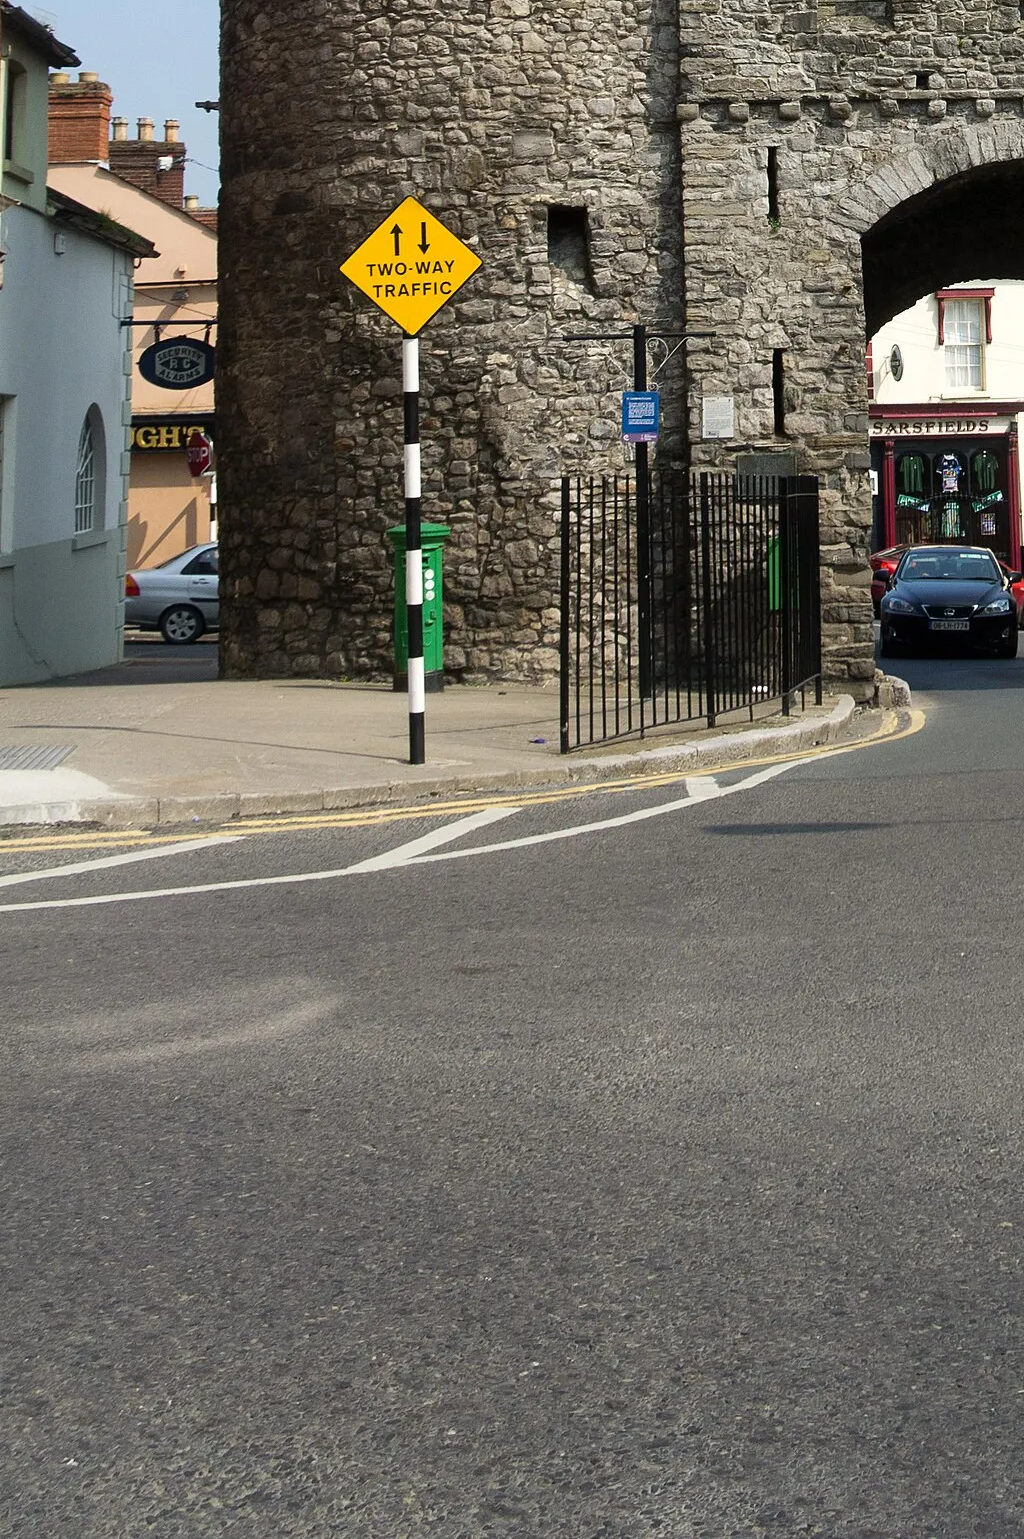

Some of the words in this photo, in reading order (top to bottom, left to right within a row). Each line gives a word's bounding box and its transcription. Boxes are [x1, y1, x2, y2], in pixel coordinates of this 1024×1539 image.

[366, 259, 455, 277] TWO-WAY
[373, 281, 452, 298] TRAFFIC
[157, 347, 202, 362] SECURITY
[159, 368, 200, 381] ALARMS
[872, 419, 990, 435] SARSFIELDS
[188, 447, 209, 463] STOP
